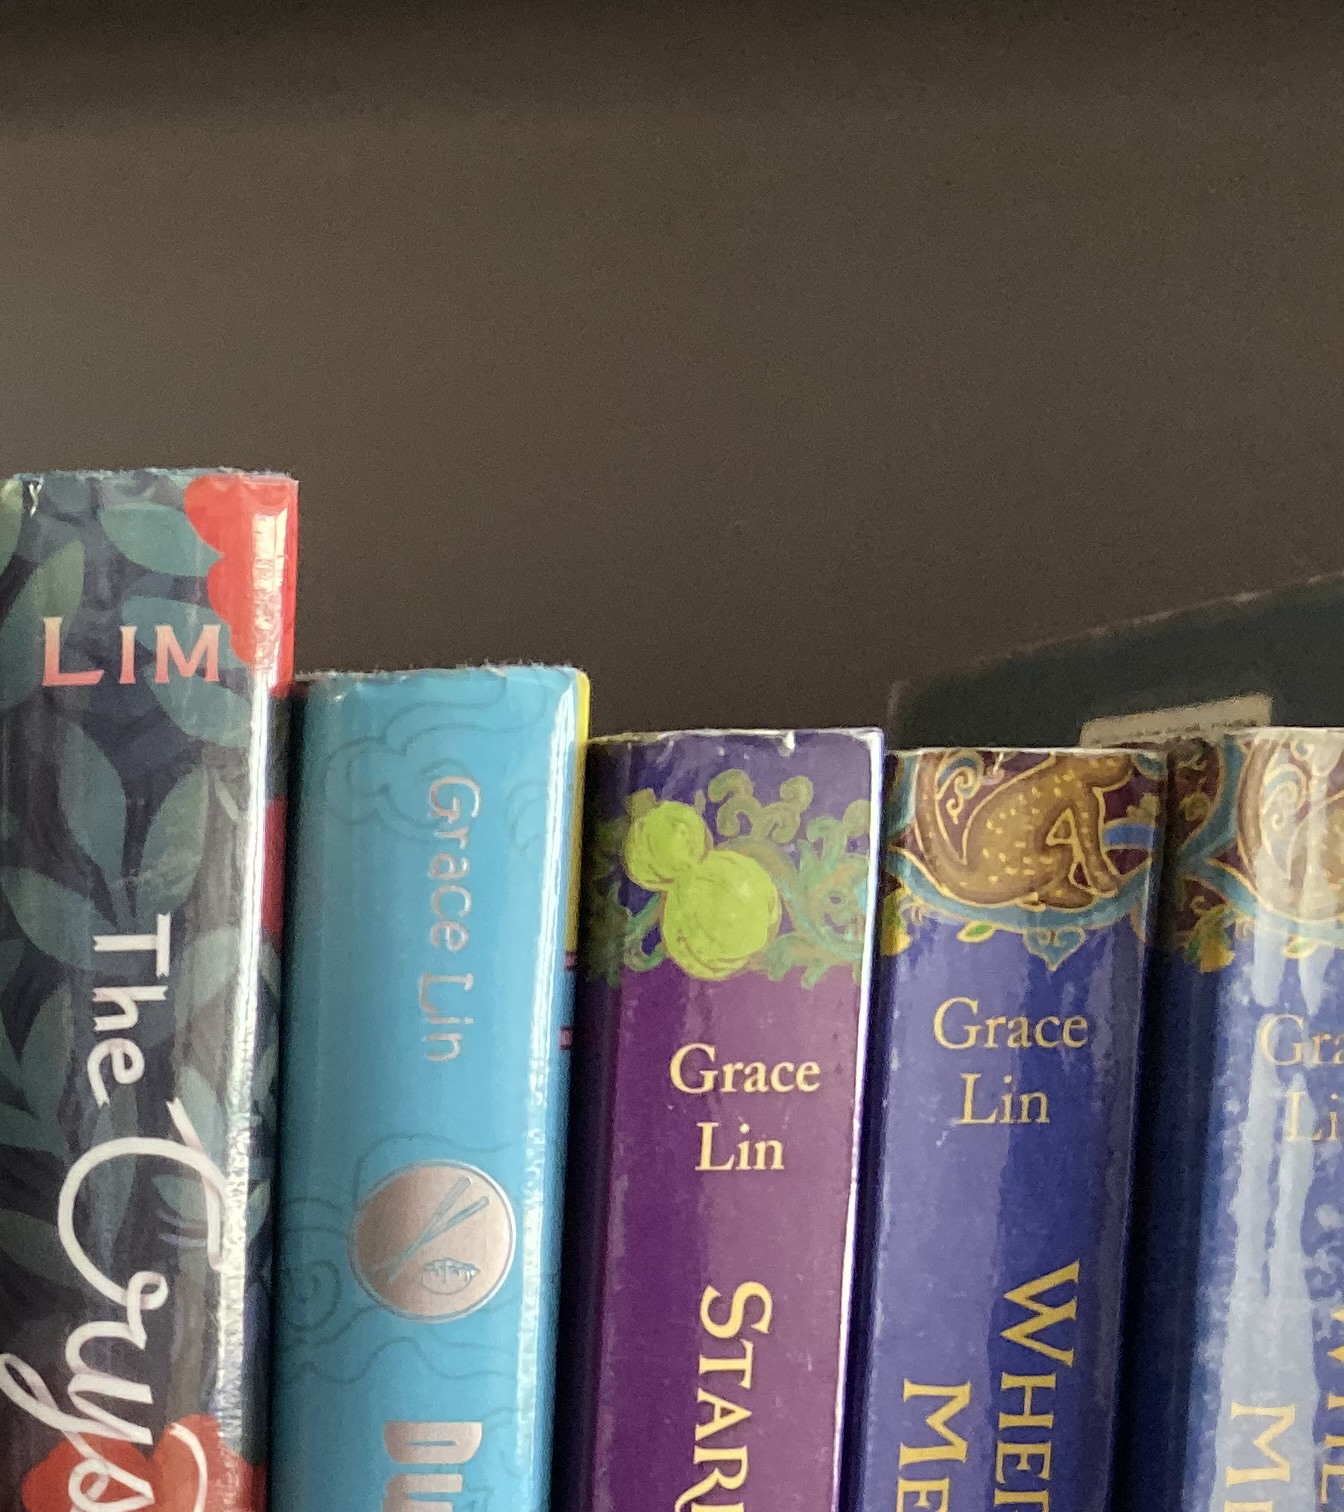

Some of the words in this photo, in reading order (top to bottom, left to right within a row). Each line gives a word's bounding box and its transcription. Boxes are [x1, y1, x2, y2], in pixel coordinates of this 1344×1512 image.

[41, 616, 221, 688] LIM
[429, 775, 482, 952] Grace
[418, 970, 475, 1064] Lin
[932, 996, 1089, 1051] Grace
[669, 1042, 821, 1095] Grace
[957, 1071, 1050, 1125] Lin
[695, 1120, 785, 1173] Lin
